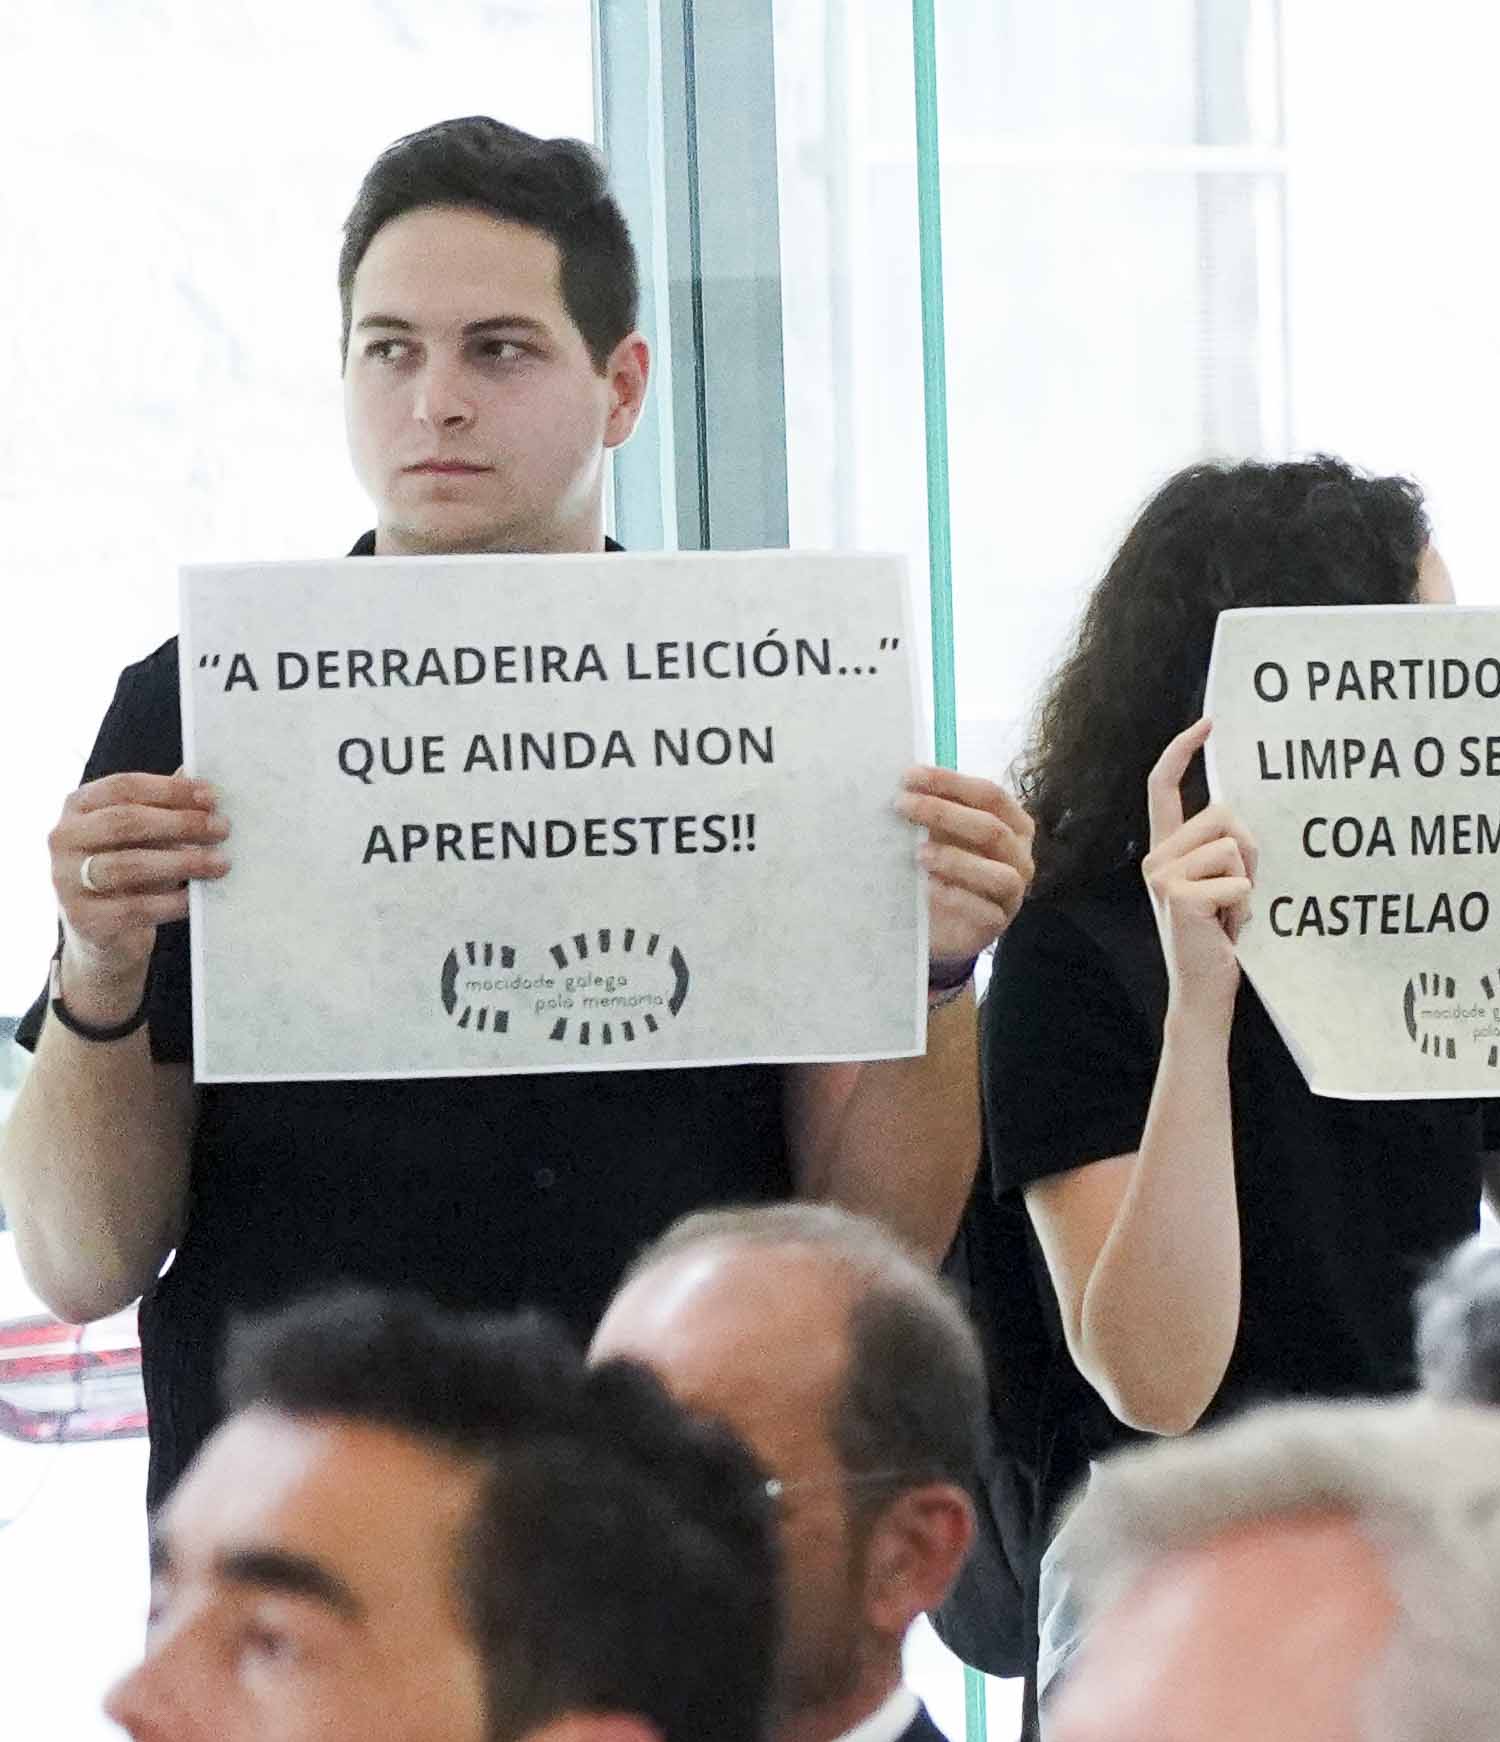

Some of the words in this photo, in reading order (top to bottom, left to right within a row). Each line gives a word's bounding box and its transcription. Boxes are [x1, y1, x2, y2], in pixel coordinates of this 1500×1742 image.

[200, 653, 259, 692] “A
[277, 644, 608, 690] DERRADEIRA
[1254, 662, 1288, 702] O
[338, 736, 445, 784] QUE
[464, 730, 636, 772] AINDA
[655, 726, 773, 766] NON
[1257, 738, 1400, 780] LIMPA
[1414, 737, 1444, 777] O
[362, 814, 755, 864] APRENDESTES!!
[1303, 816, 1396, 858] COA
[1270, 892, 1489, 937] CASTELAO
